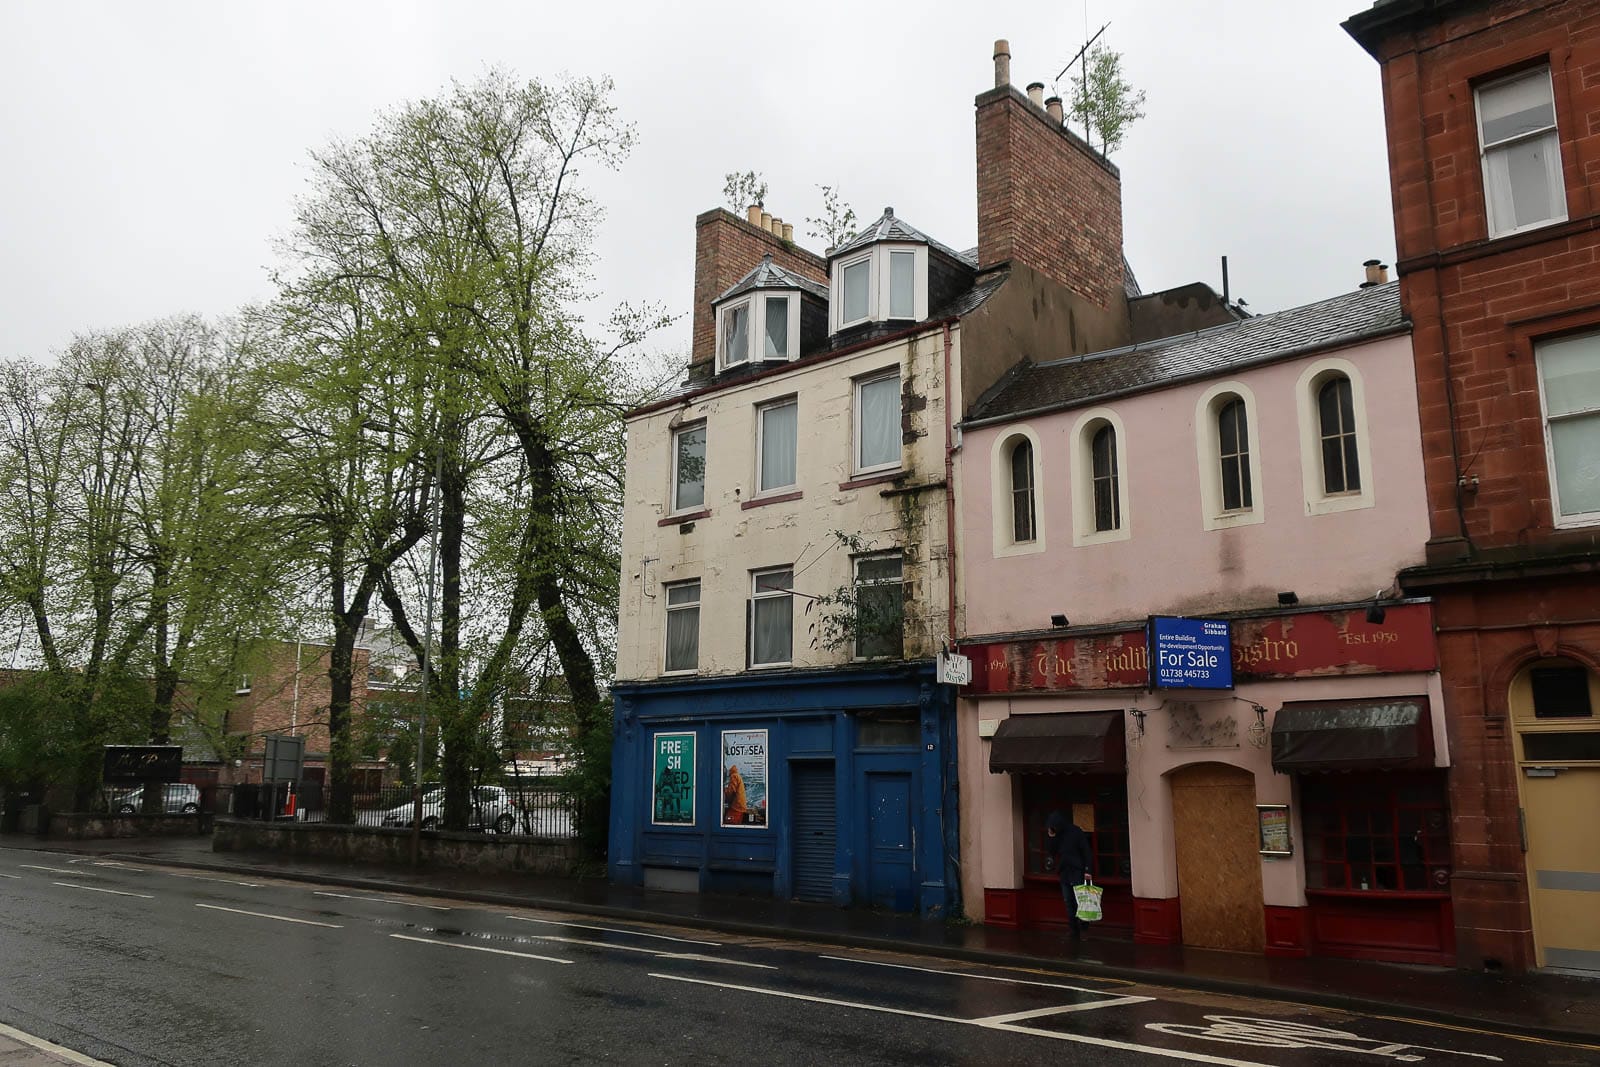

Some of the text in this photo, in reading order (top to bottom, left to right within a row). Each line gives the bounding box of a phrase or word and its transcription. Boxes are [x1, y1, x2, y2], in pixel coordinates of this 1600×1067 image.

[1175, 634, 1196, 643] Building
[1372, 631, 1398, 643] 1950
[1197, 644, 1225, 652] Opportunity
[1160, 650, 1218, 668] For Sale
[945, 671, 966, 684] BISTRO
[1160, 669, 1210, 679] 01738 445733
[660, 740, 682, 755] FRE
[726, 745, 745, 756] LOST
[749, 744, 764, 755] SEA
[667, 755, 681, 770] SH
